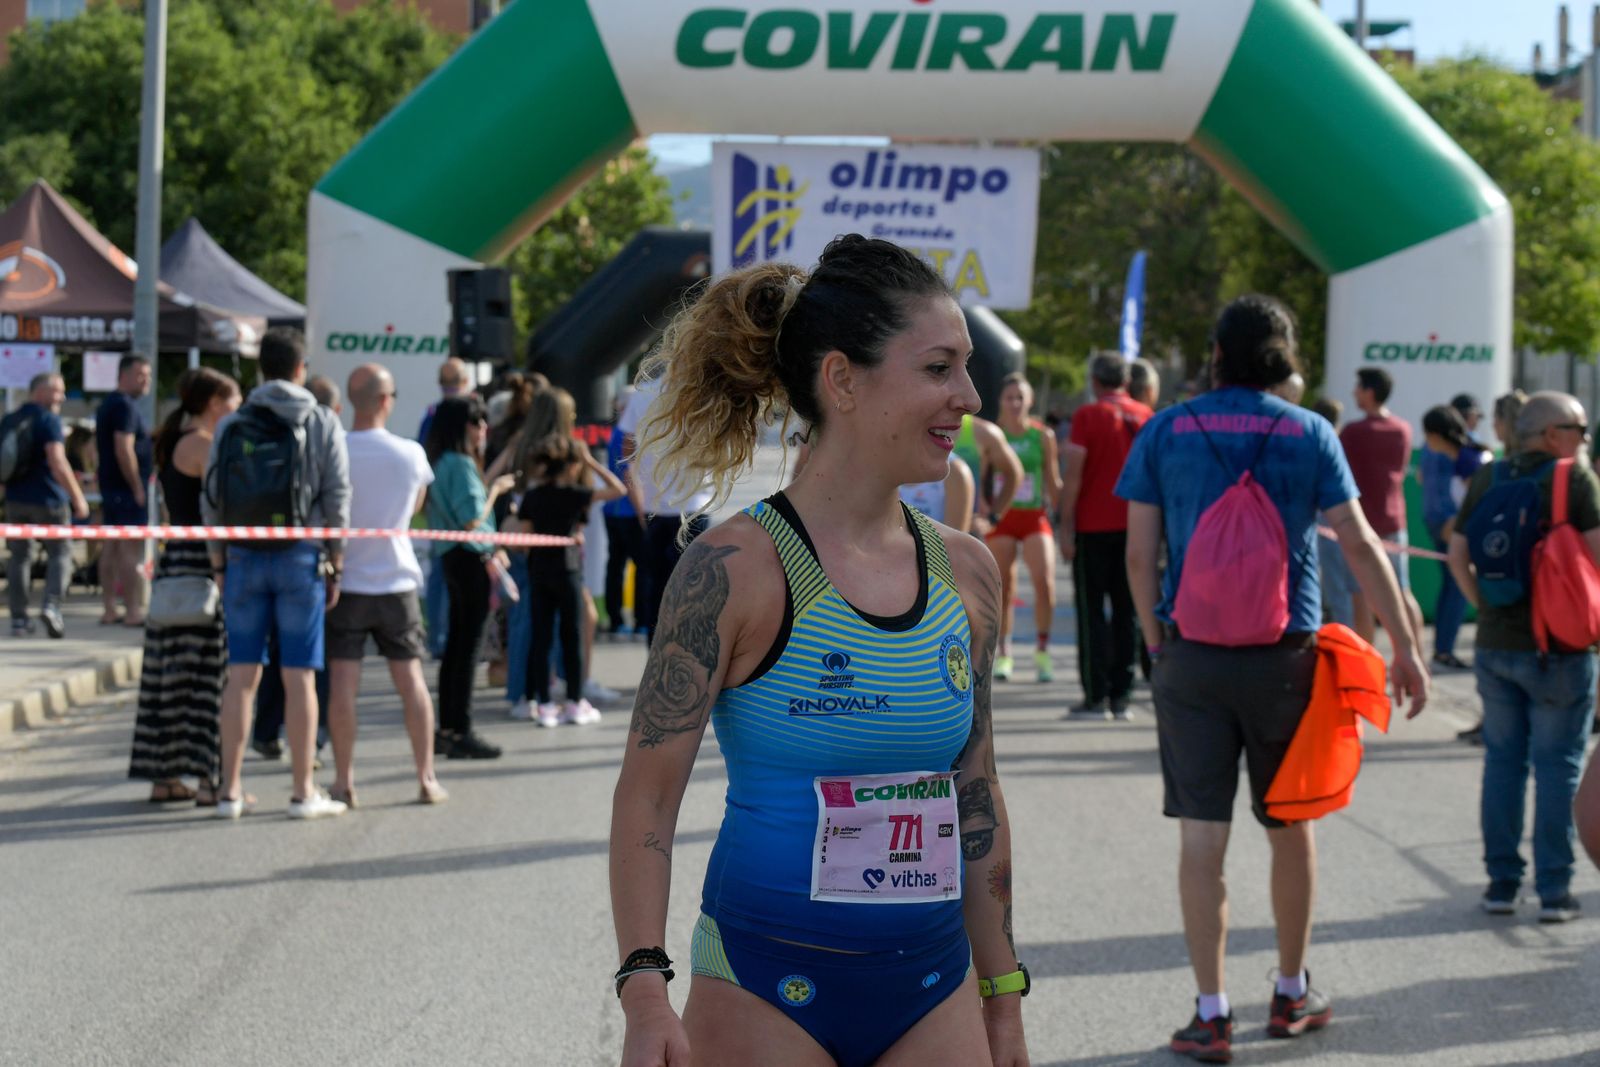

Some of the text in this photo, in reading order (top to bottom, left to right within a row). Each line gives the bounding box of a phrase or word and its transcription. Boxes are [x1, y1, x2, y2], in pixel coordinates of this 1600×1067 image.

[674, 0, 1178, 72] COVIRAN
[830, 151, 1009, 202] olimpo
[822, 196, 936, 219] deportes
[872, 223, 955, 239] Granada
[1364, 332, 1496, 363] COVIRAN
[820, 674, 854, 683] SPORTING
[889, 814, 923, 850] 771
[889, 852, 922, 863] CARMINA
[890, 870, 937, 888] vithas
